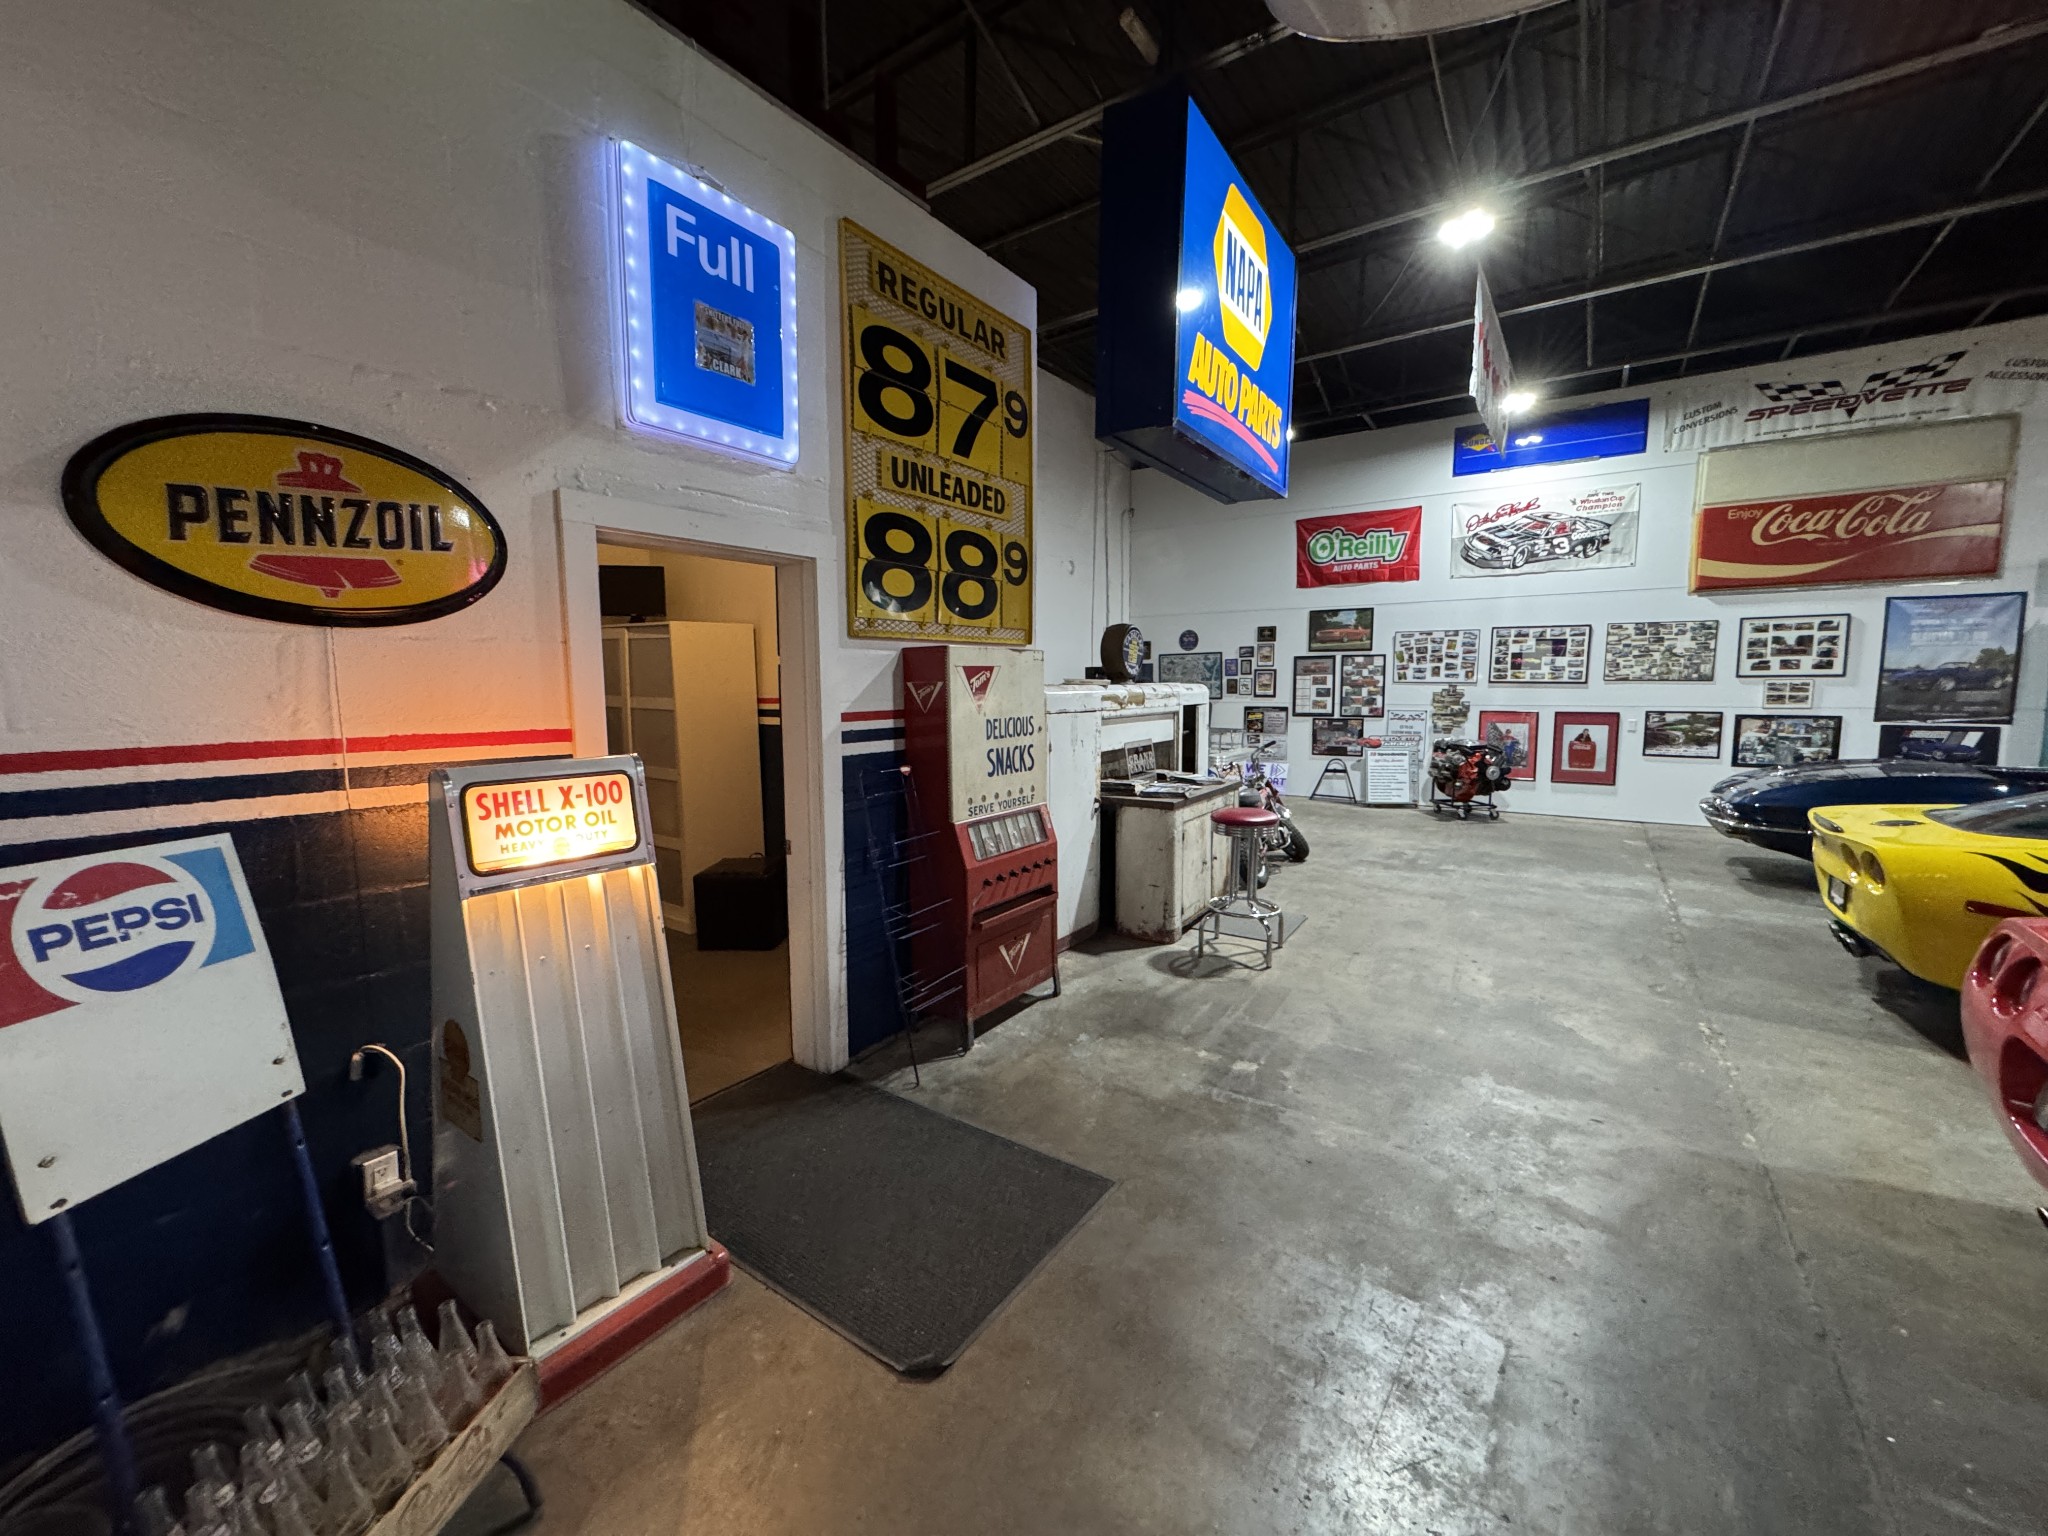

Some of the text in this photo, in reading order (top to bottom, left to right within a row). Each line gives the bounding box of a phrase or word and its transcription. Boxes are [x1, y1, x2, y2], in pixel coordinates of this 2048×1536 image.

[666, 203, 754, 293] Full
[1225, 228, 1263, 333] NAPA
[877, 260, 1006, 360] REGULAR
[712, 358, 742, 379] CLARK
[1188, 332, 1282, 449] AUTO PARTS
[1744, 378, 1974, 422] SPEEDVETTE
[1673, 406, 1738, 434] CONVERSIONS
[1683, 401, 1723, 420] CUSTOM
[891, 456, 1006, 515] UNLEADED
[165, 482, 454, 552] PENNZOIL
[1576, 502, 1623, 512] Champion
[1728, 487, 1945, 546] Enjoy Coca-Cola
[1308, 530, 1402, 561] O'Reilly
[1552, 537, 1570, 555] 3
[1332, 561, 1379, 573] AUTO PARTS
[969, 670, 991, 693] Tom's
[986, 716, 1034, 740] DELICIOUS
[987, 744, 1035, 778] SNACKS
[476, 780, 623, 821] SHELL X-100
[968, 794, 1035, 817] SERVE YOURSELF
[495, 810, 617, 840] MOTOR OIL
[500, 840, 544, 854] HEAVY
[26, 893, 204, 963] PEPSI
